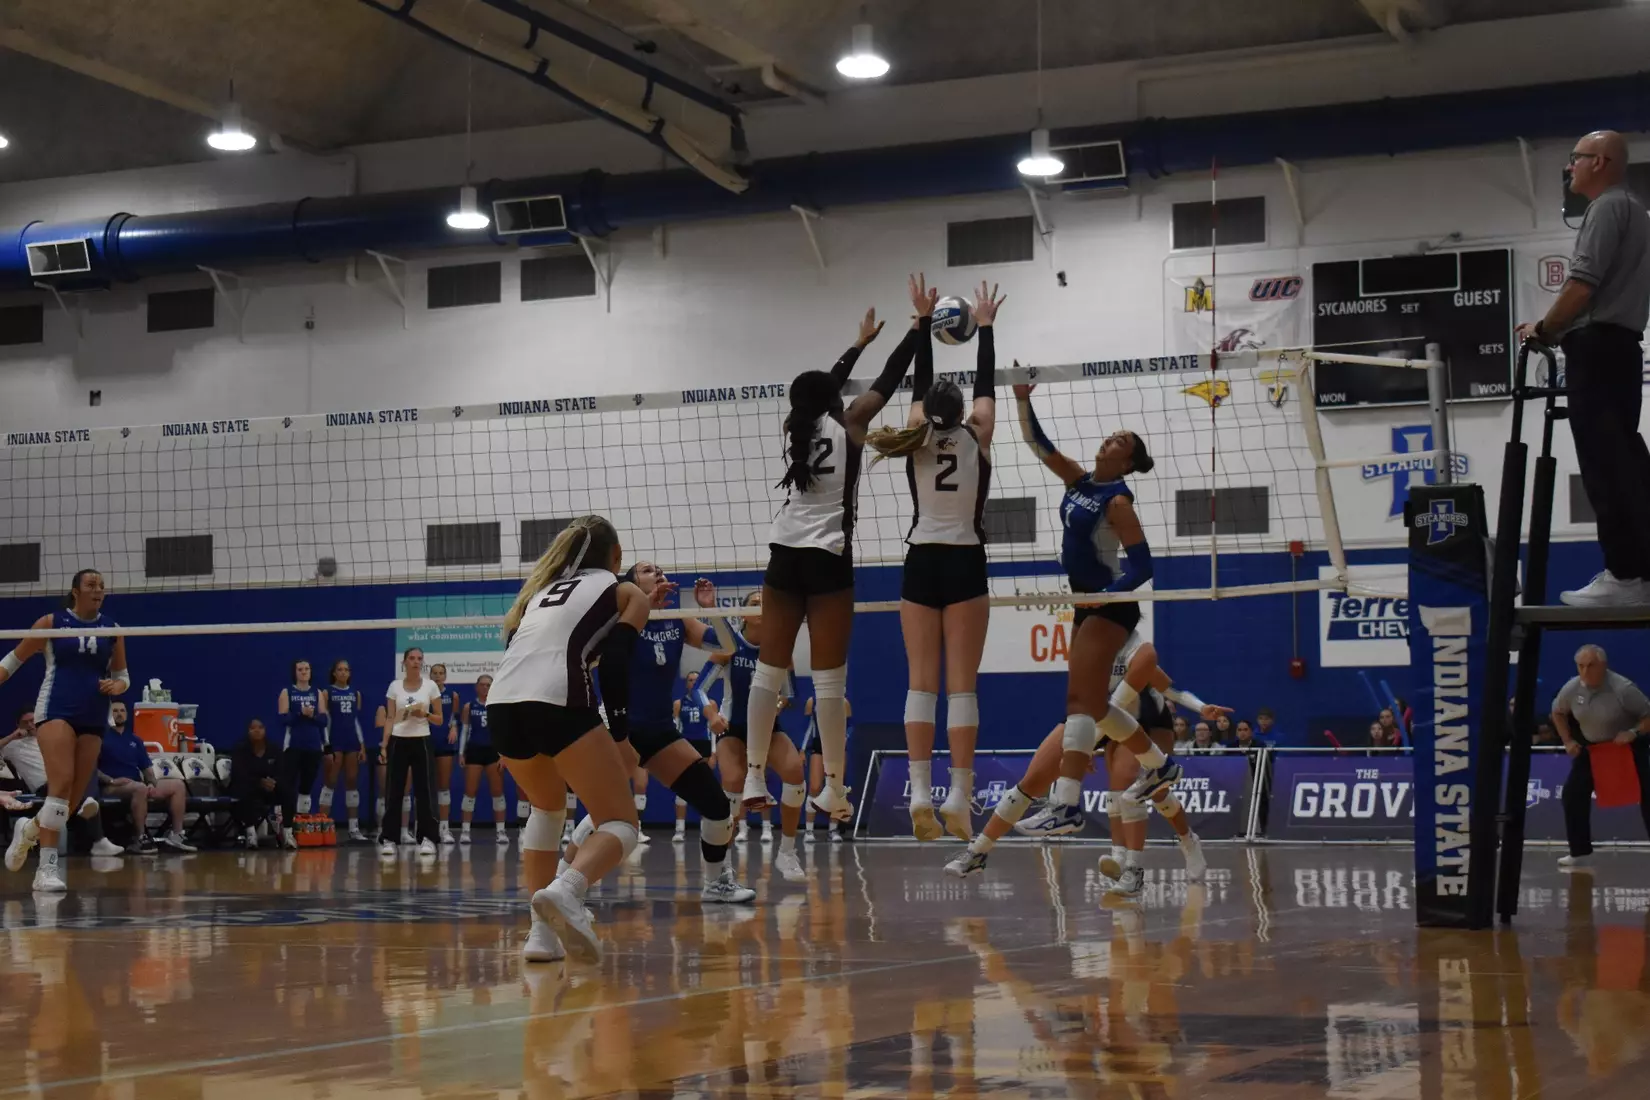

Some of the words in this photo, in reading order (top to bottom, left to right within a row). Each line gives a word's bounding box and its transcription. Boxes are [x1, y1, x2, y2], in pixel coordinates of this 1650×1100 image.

[1251, 278, 1302, 300] UIC
[1454, 289, 1501, 307] GUEST
[1318, 299, 1388, 317] SYCAMORES
[1401, 303, 1420, 313] SET
[1479, 344, 1504, 355] SETS
[1082, 359, 1144, 377] INDIANA
[1149, 354, 1199, 371] STATE
[939, 370, 977, 386] STAT
[681, 387, 737, 404] INDIANA
[741, 383, 785, 400] STATE
[1479, 383, 1506, 394] WON
[499, 400, 551, 415] INDIANA
[554, 396, 597, 412] STATE
[1319, 393, 1347, 403] WON
[325, 411, 375, 426] INDIANA
[378, 408, 418, 423] STATE
[162, 422, 209, 437] INDIANA
[212, 419, 250, 434] STATE
[7, 432, 51, 446] INDIANA
[55, 429, 90, 443] STATE
[935, 454, 958, 491] 2
[1363, 456, 1467, 478] SYCAMOS
[1416, 513, 1467, 526] SYCAMORES
[539, 580, 582, 608] 9
[430, 631, 483, 641] community
[1030, 623, 1069, 662] CA
[653, 642, 667, 666] 6
[1418, 604, 1472, 776] INDIANA
[340, 701, 353, 714] 22
[1355, 768, 1380, 779] THE
[1293, 782, 1416, 818] GROV
[1434, 783, 1471, 897] STATE
